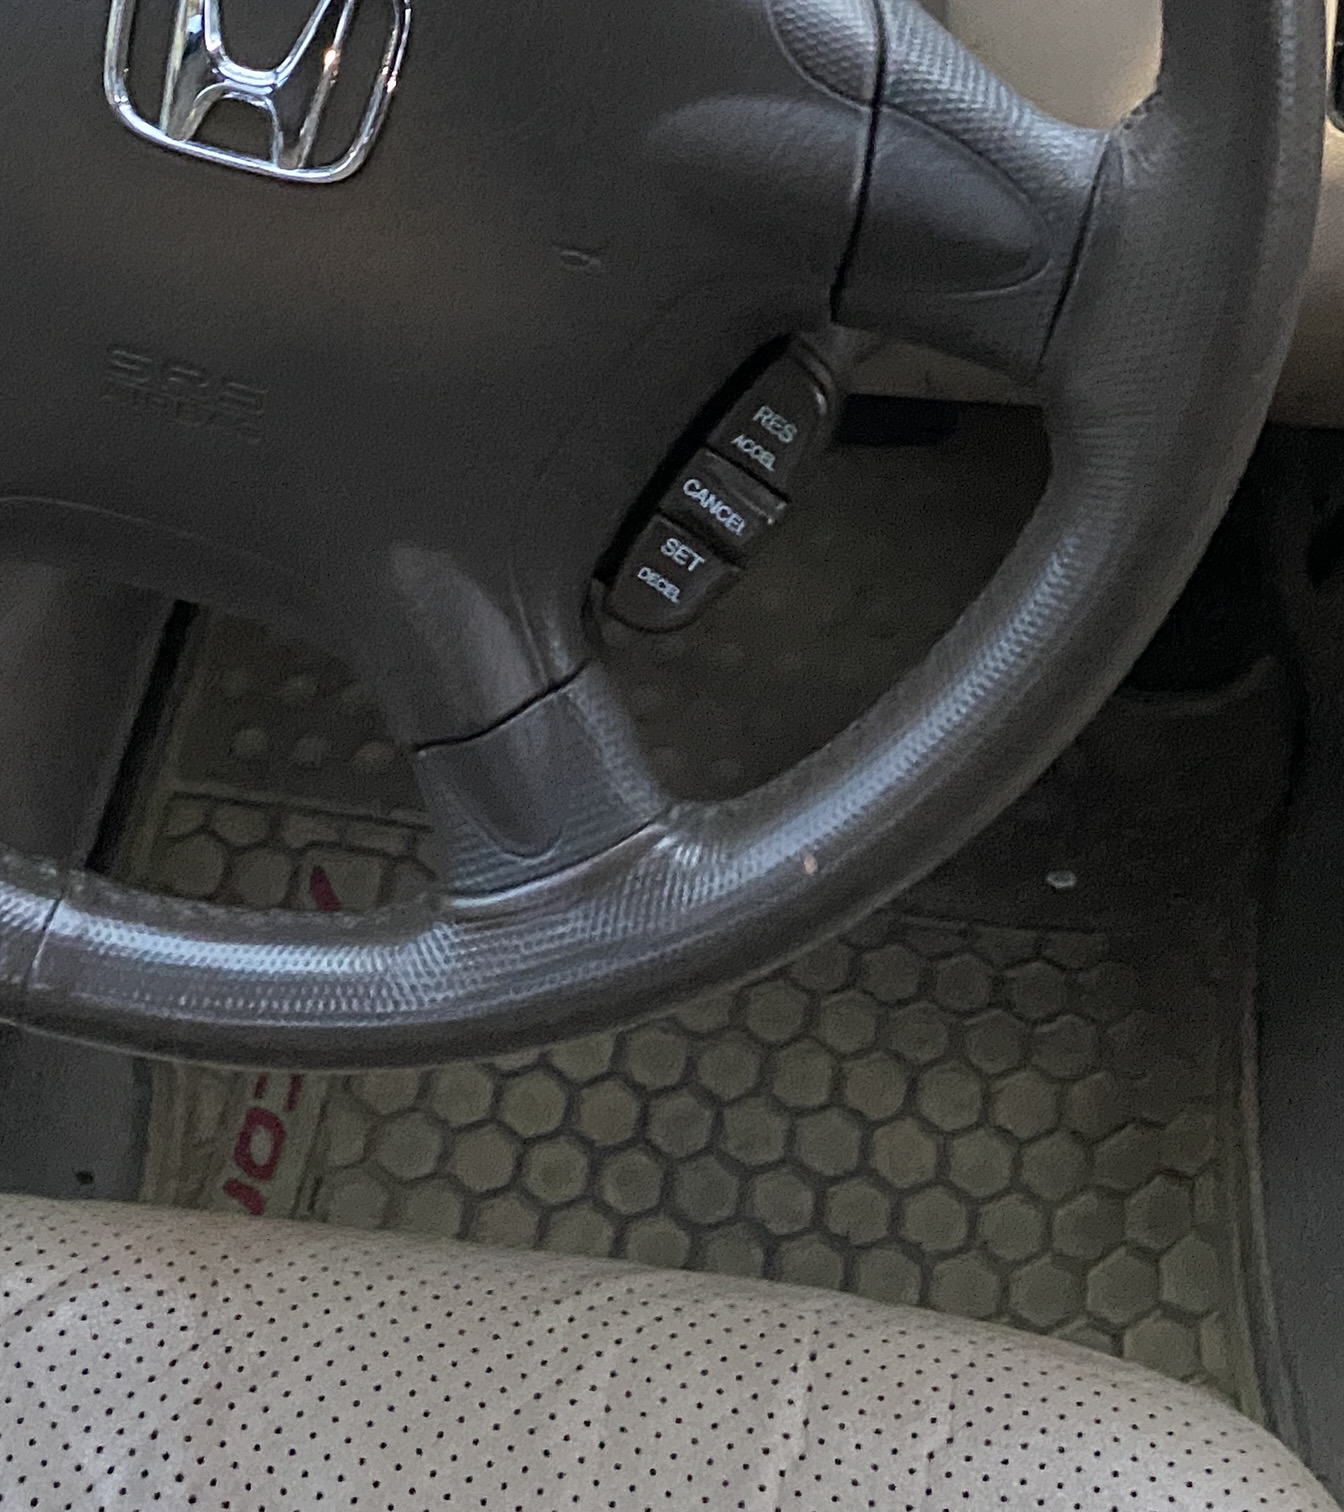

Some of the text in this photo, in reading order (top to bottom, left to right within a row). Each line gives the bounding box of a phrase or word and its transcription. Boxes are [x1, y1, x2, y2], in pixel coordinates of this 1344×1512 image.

[753, 405, 798, 444] RES
[682, 478, 747, 537] CANCEL
[660, 537, 706, 572] SET
